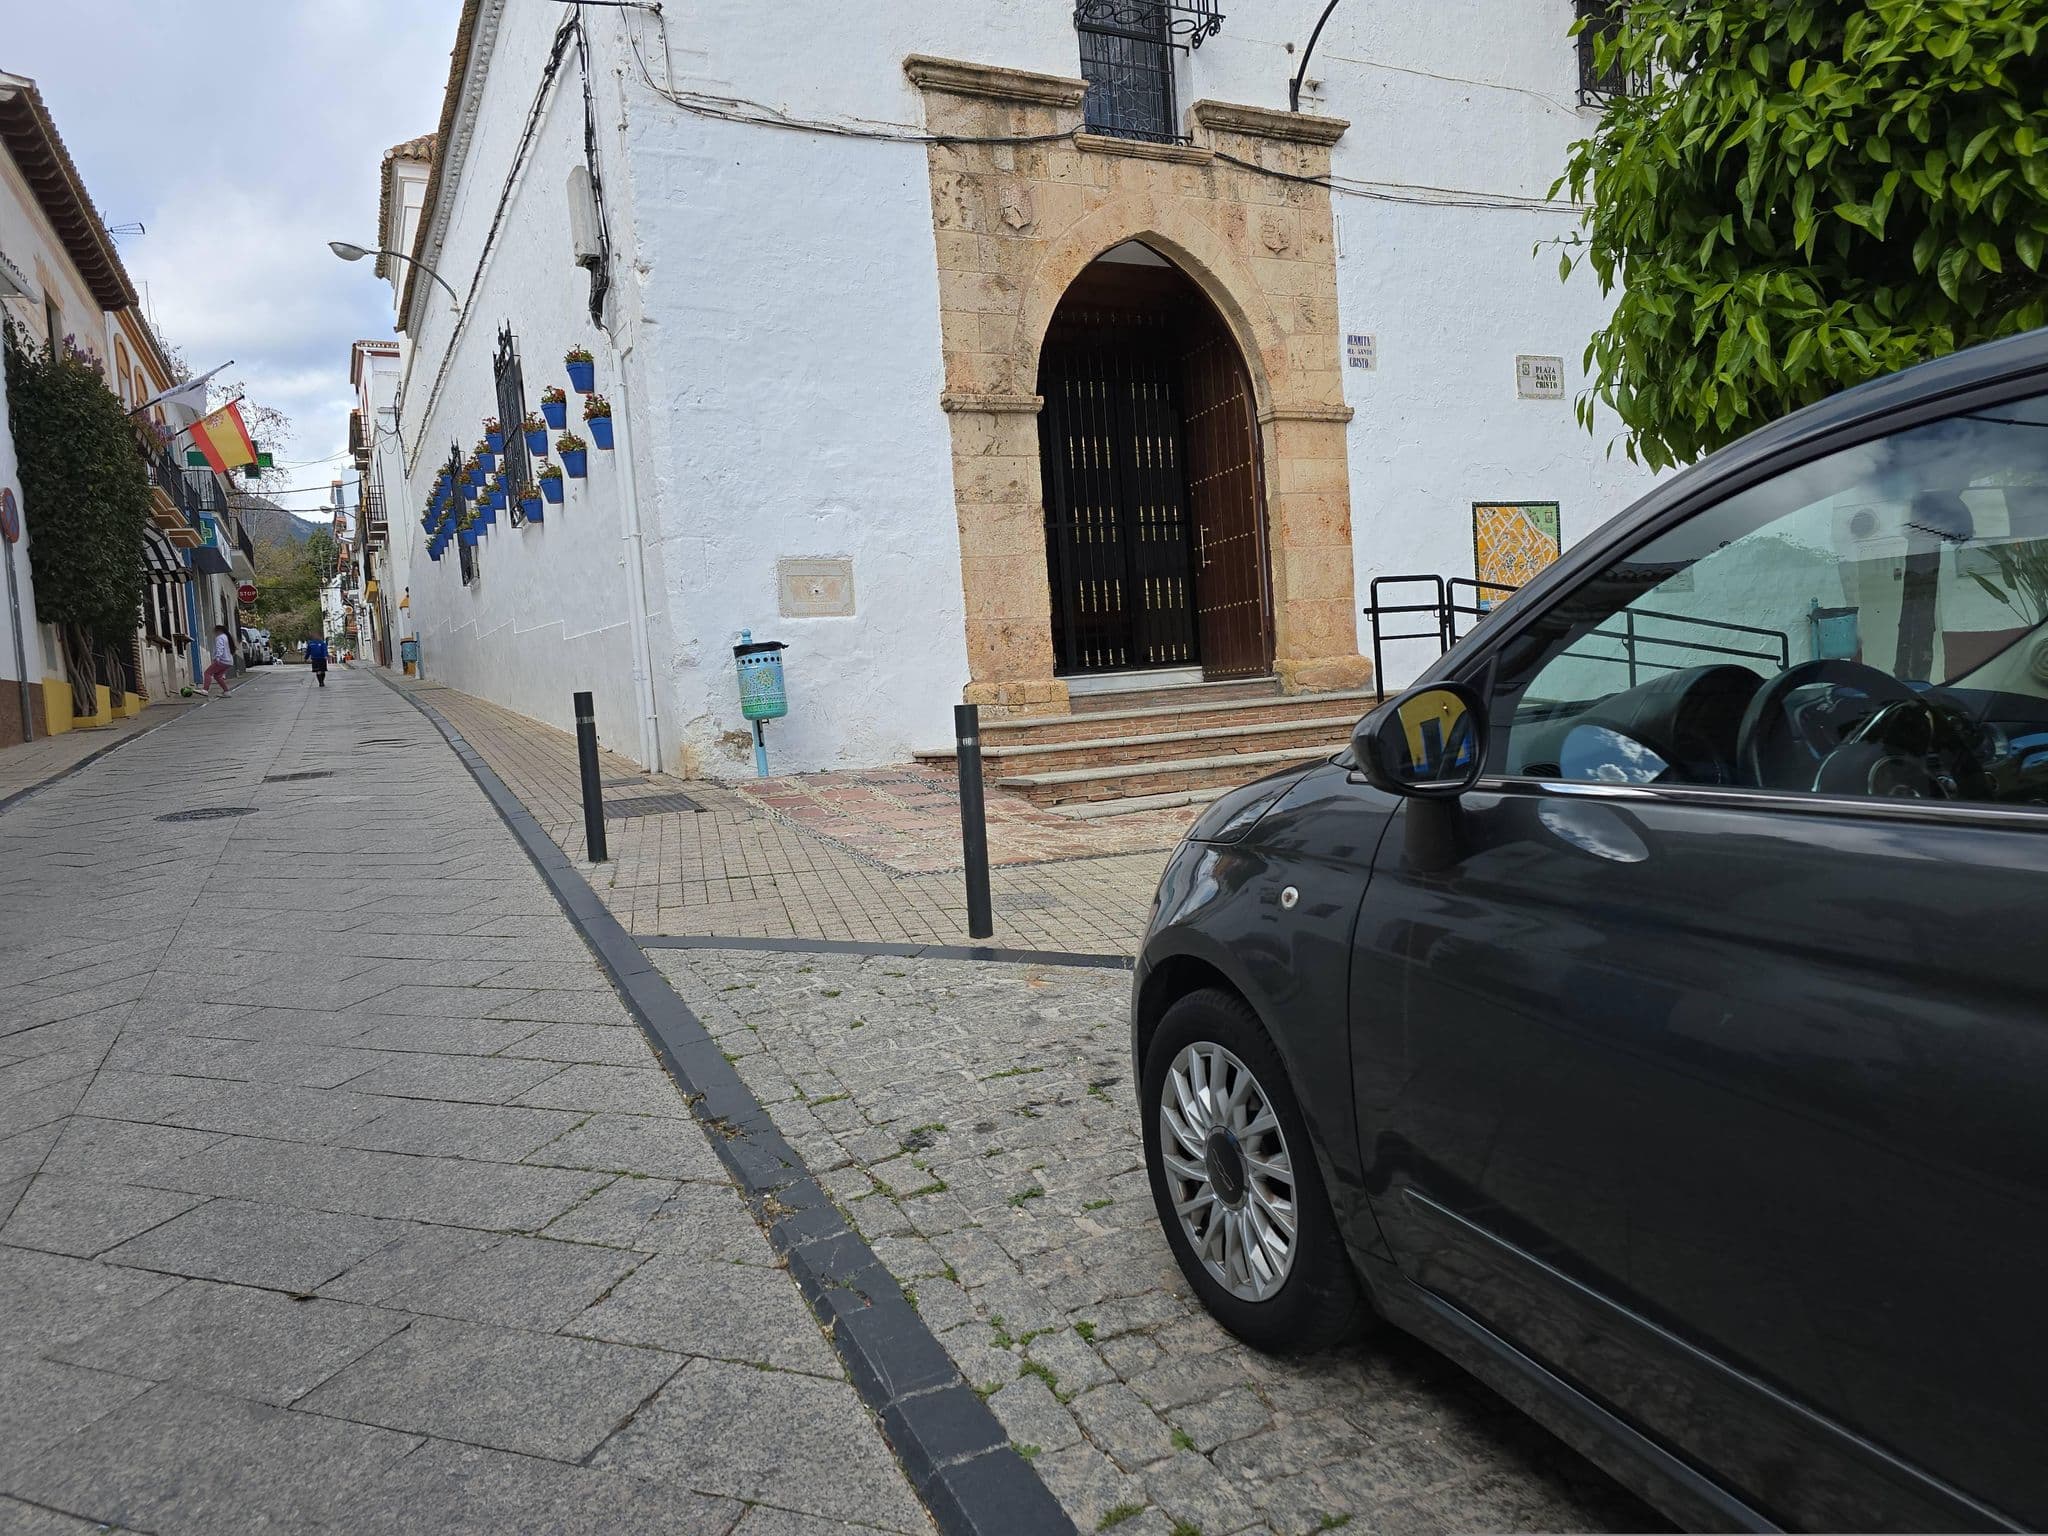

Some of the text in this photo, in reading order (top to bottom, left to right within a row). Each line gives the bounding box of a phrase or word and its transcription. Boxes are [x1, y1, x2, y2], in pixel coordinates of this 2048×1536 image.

[1358, 348, 1372, 356] SANTO
[1349, 357, 1369, 368] CRISTO
[1535, 366, 1556, 374] PLAZA
[1535, 381, 1558, 389] CRISTO
